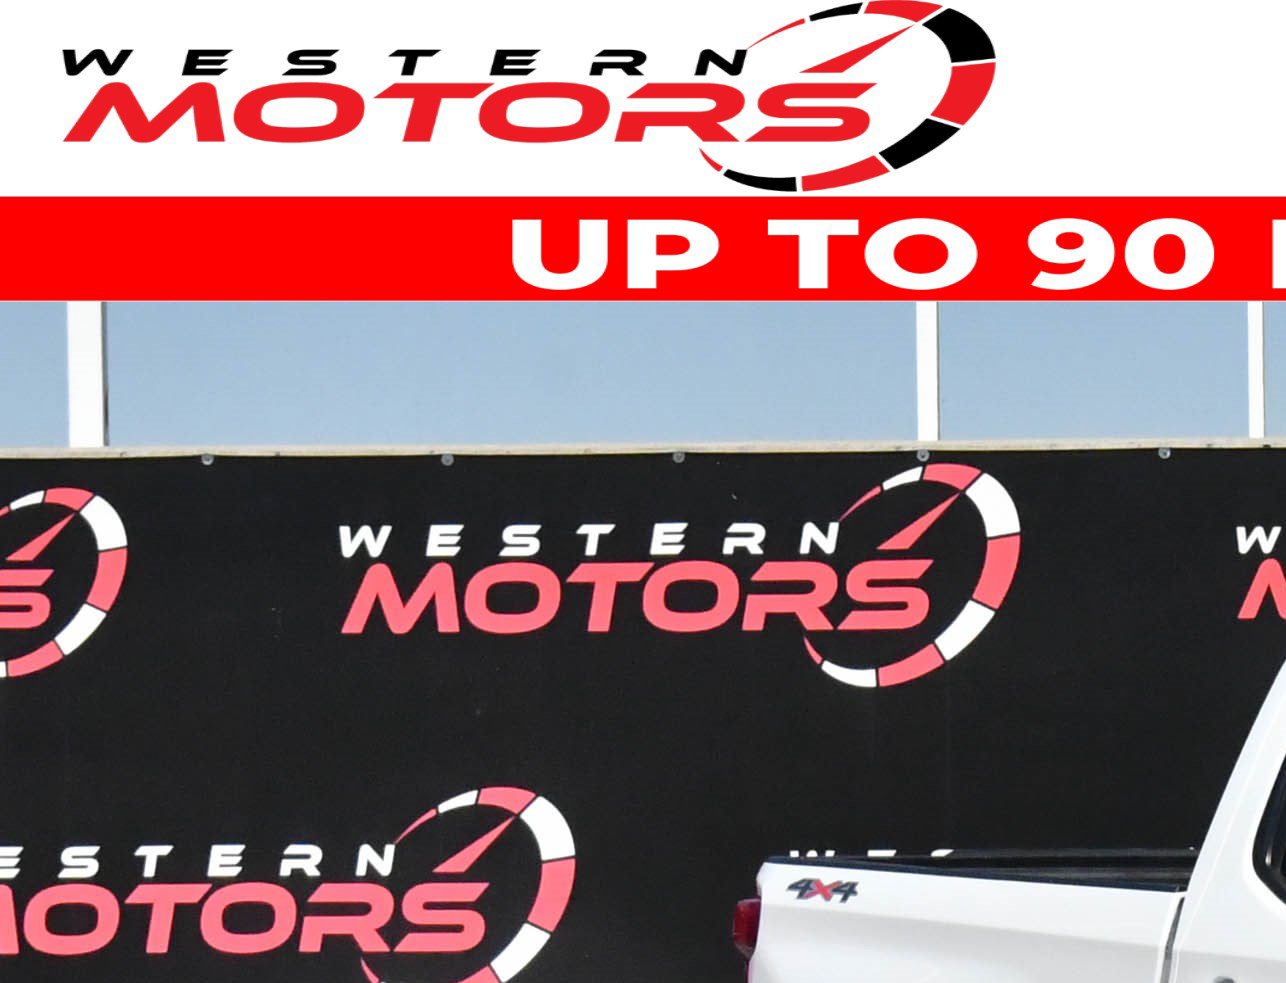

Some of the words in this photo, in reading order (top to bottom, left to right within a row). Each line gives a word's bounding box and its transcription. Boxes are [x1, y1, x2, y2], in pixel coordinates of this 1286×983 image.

[339, 521, 840, 558] WESTERN
[341, 558, 934, 634] MOTORS
[0, 843, 396, 879] ESTERN
[0, 881, 490, 957] OTORS
